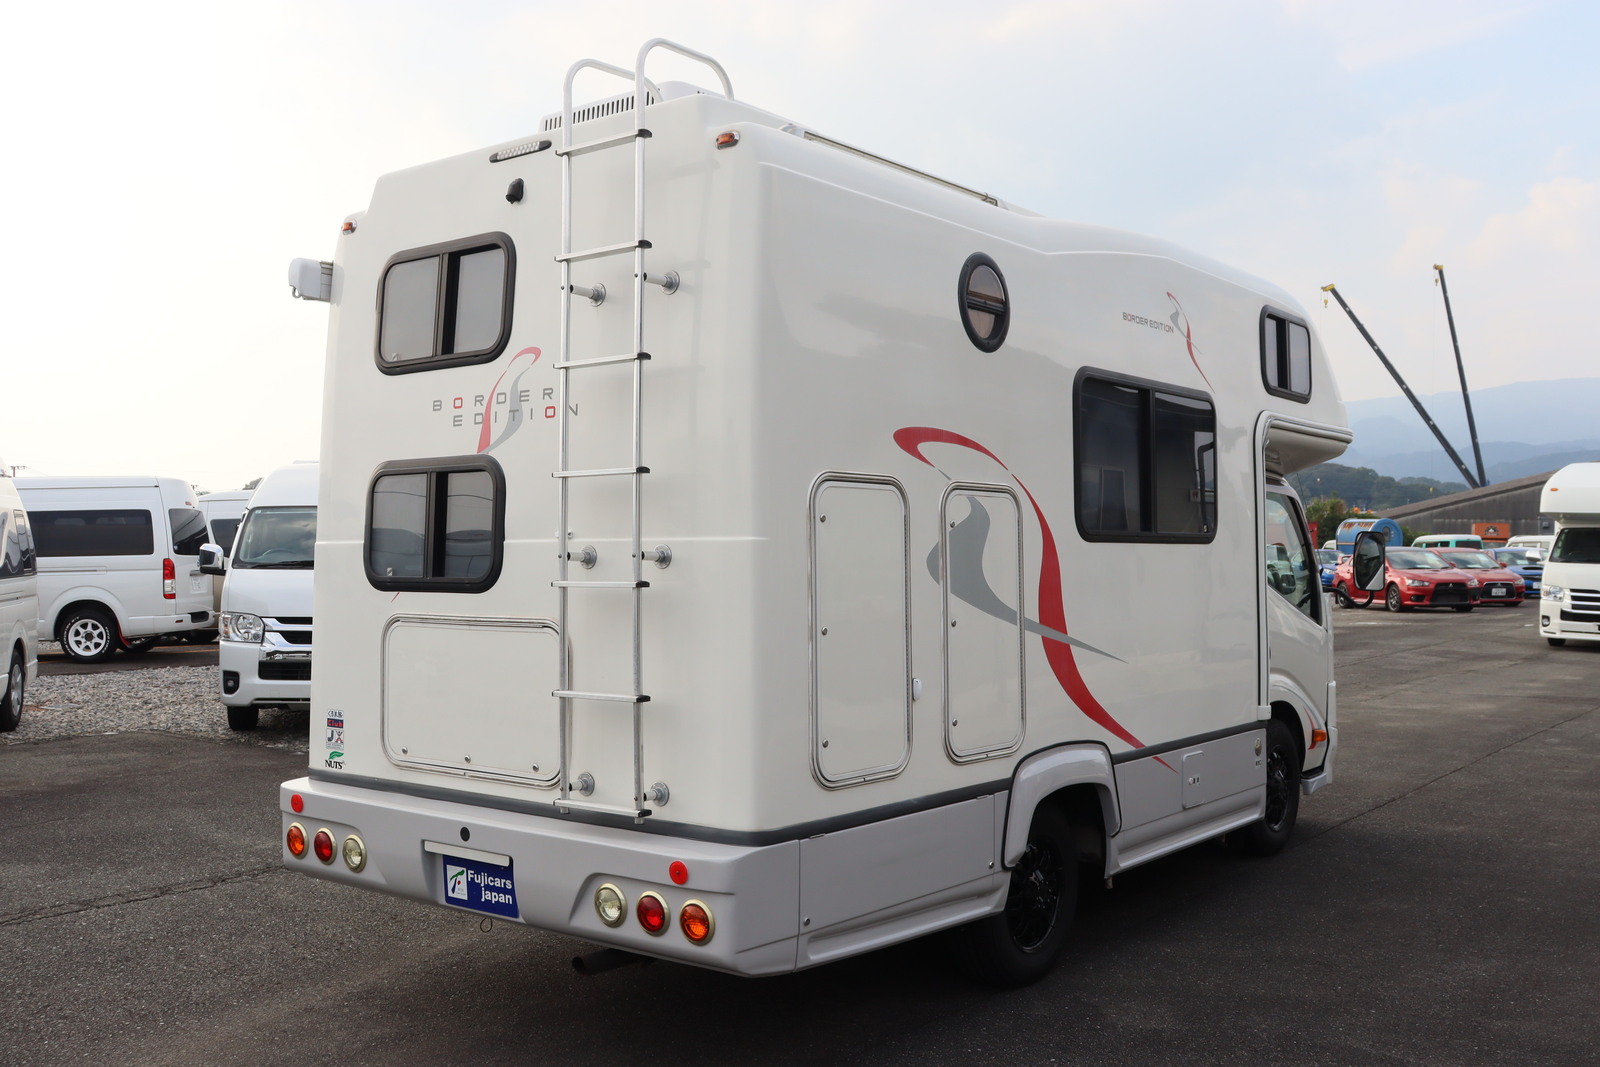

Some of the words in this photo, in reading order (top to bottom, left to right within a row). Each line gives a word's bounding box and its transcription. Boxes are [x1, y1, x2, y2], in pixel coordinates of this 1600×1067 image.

[1122, 312, 1149, 327] BORDER
[1149, 320, 1174, 333] EDITION
[432, 387, 554, 412] BORDER
[453, 403, 579, 427] EDITION
[325, 760, 343, 770] NUTS
[467, 870, 513, 889] Fujicars
[481, 888, 513, 904] japan
